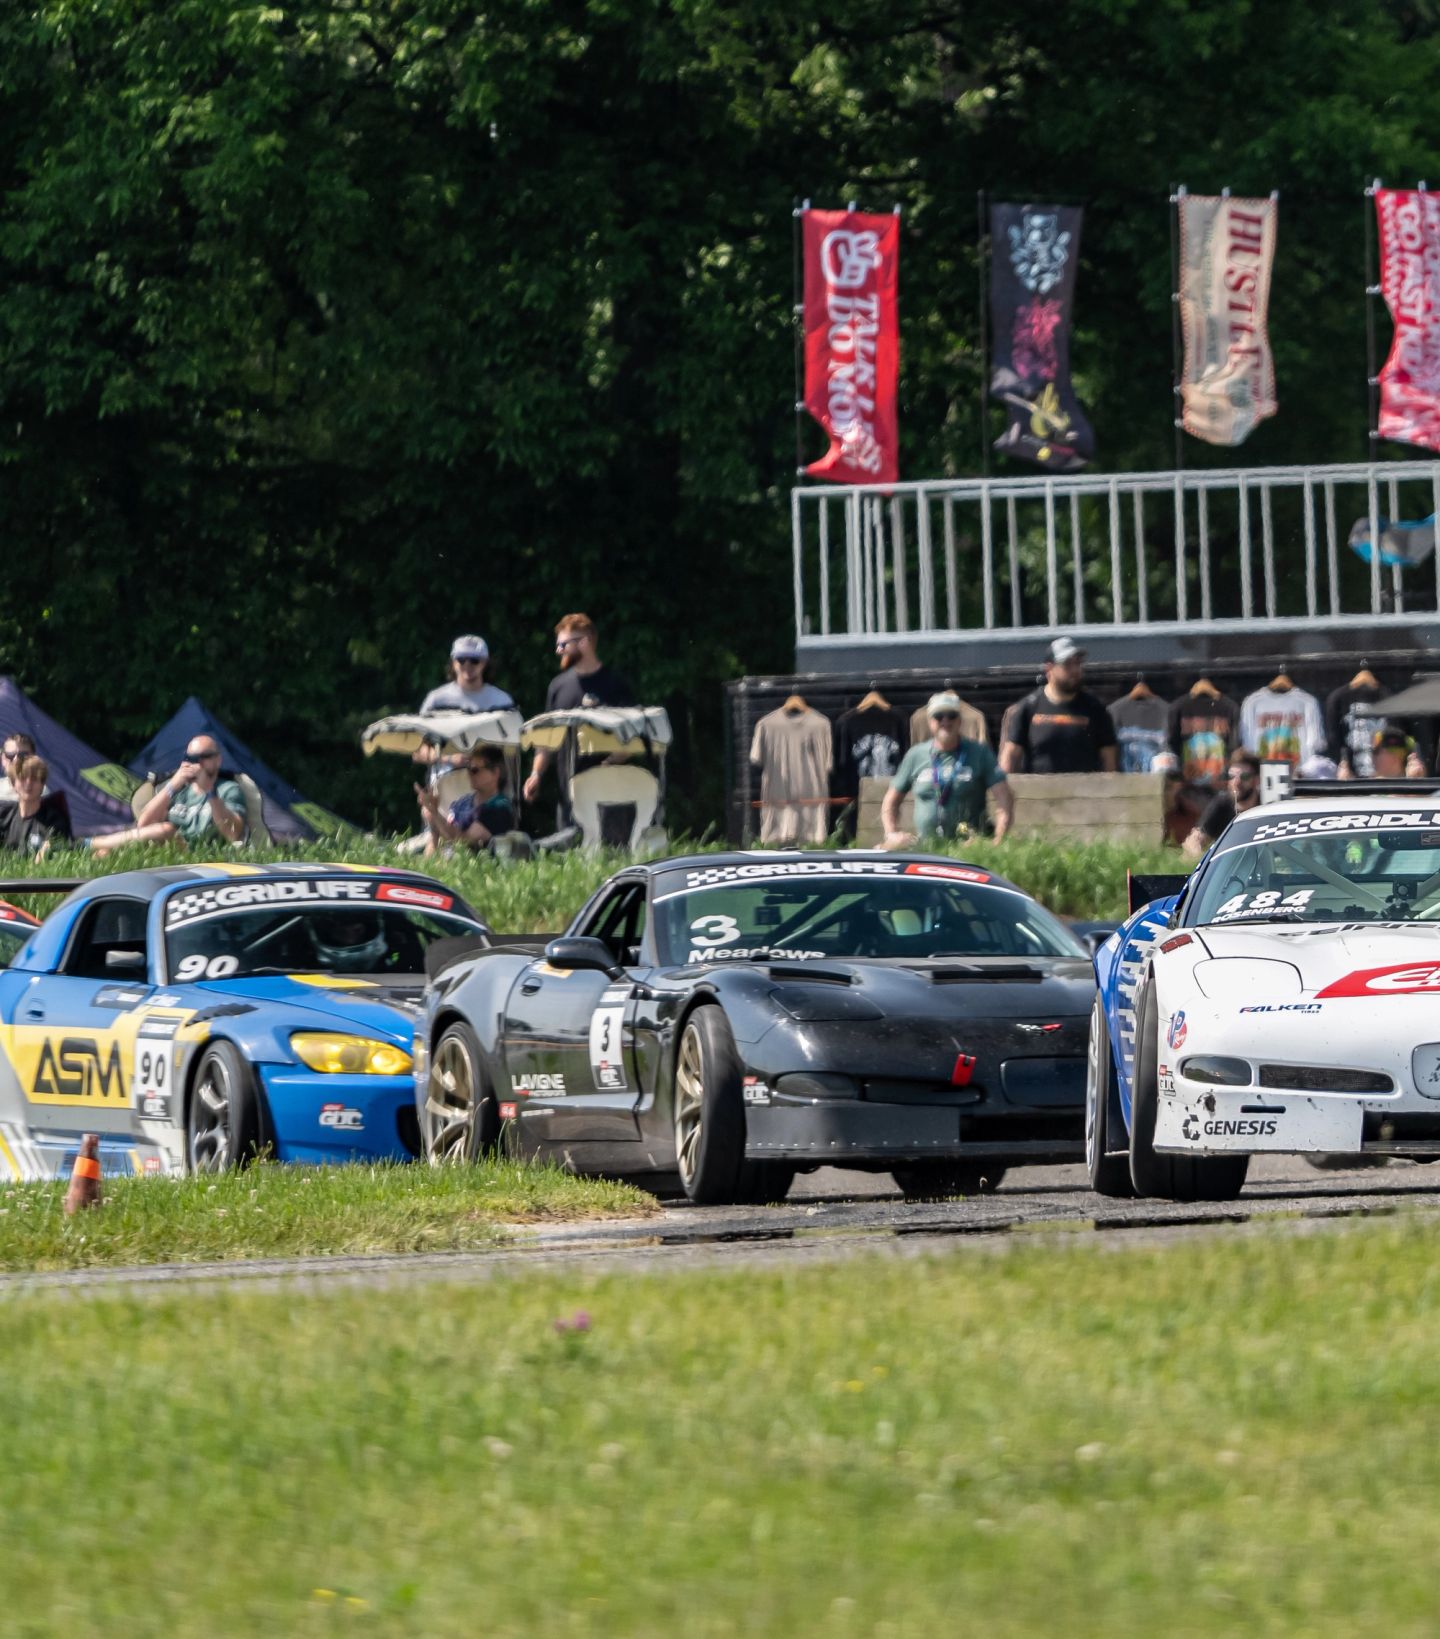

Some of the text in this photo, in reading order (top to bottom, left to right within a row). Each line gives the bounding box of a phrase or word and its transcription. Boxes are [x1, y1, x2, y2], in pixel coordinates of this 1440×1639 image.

[735, 862, 902, 878] GRIDLIFE
[216, 881, 373, 907] GRIDLIFE
[1217, 889, 1315, 915] 484
[1211, 906, 1307, 923] ROSENBERG
[690, 914, 741, 947] 3
[687, 946, 827, 963] Meadows
[174, 954, 239, 982] 90
[1240, 1003, 1322, 1014] FALKEN
[601, 1014, 611, 1053] 3
[34, 1036, 126, 1099] ASM
[141, 1050, 166, 1089] 90
[1204, 1120, 1278, 1135] GENESIS
